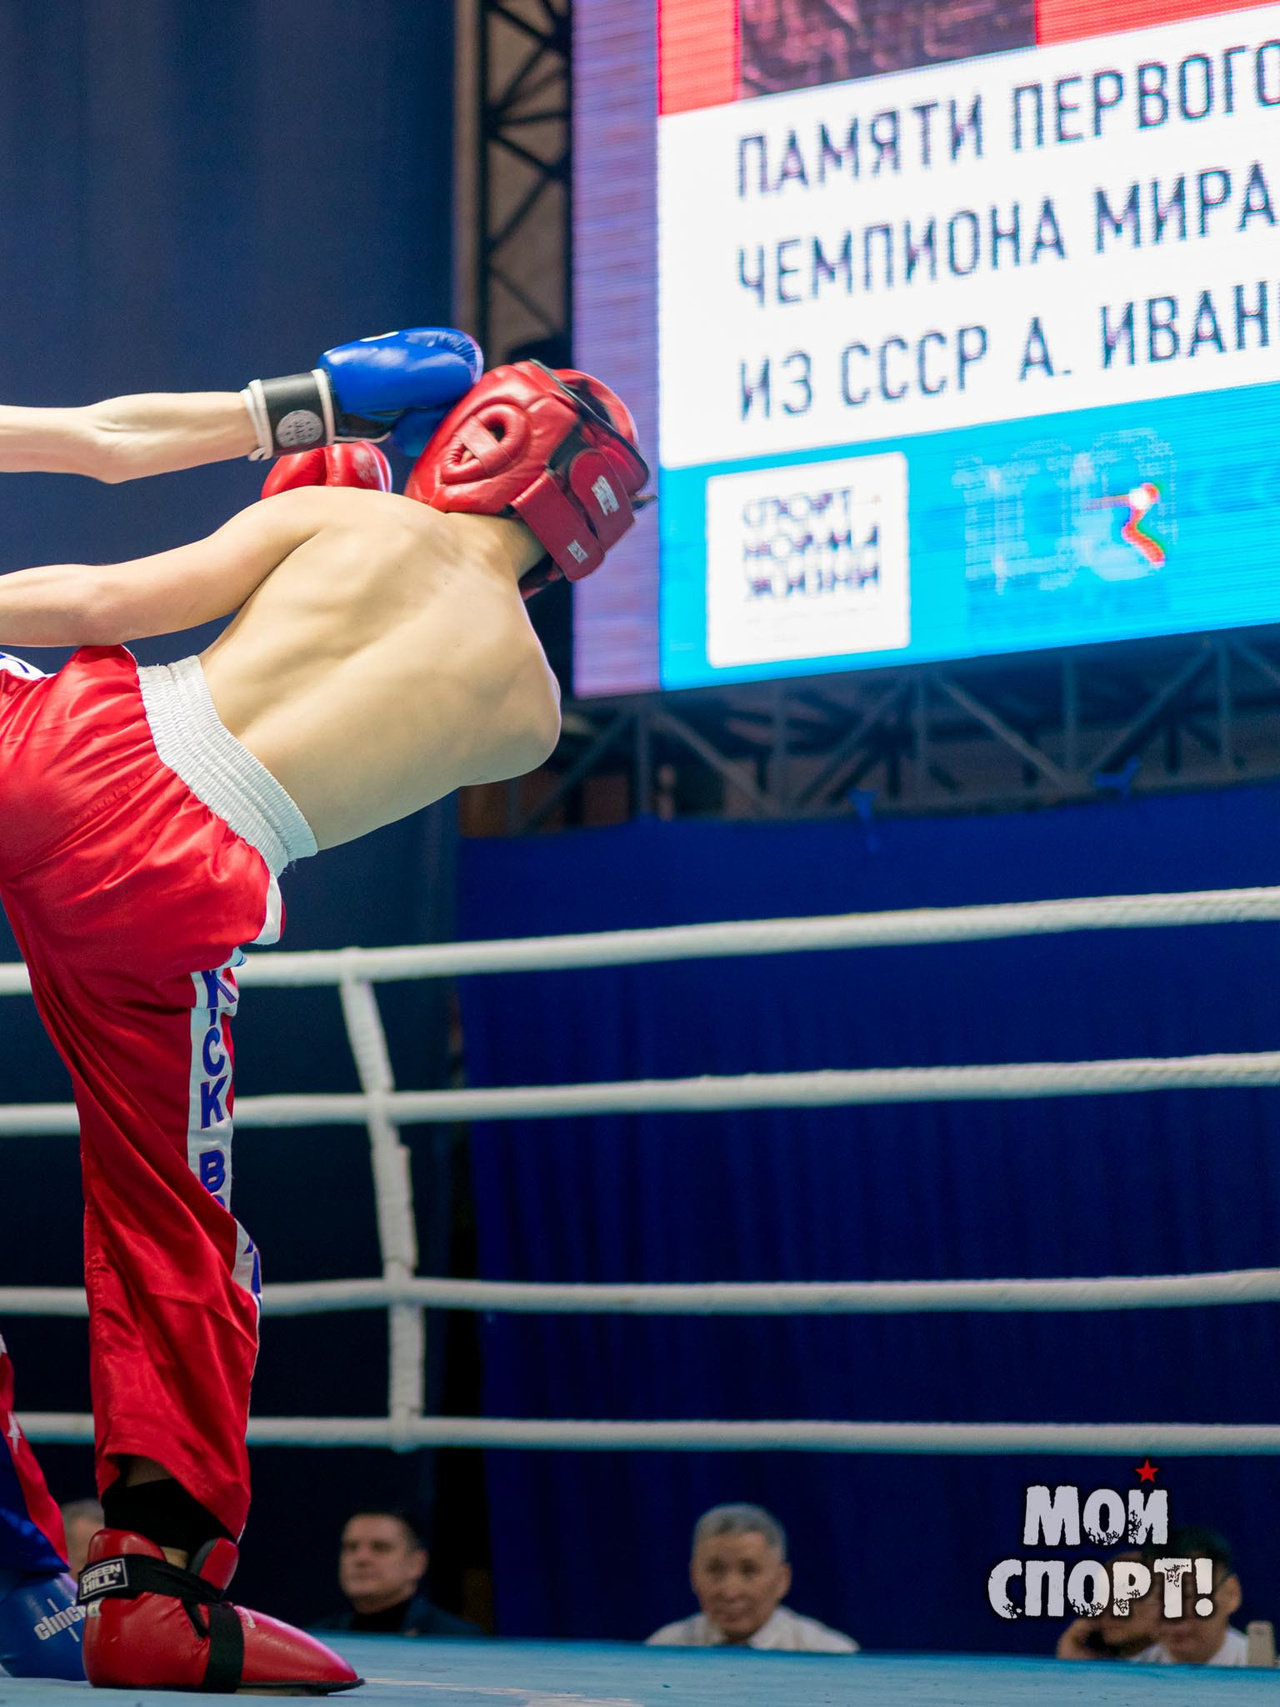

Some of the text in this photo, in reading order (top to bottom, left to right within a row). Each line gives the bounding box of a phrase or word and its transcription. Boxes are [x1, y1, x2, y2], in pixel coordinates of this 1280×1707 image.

[738, 39, 1280, 199] ПАМЯТИ ПЕРВОГО
[738, 160, 1278, 307] ЧЕМПИОНА МИРА
[740, 278, 1280, 421] ИЗ СССР А. ИВАН
[82, 1563, 121, 1584] GREEN
[83, 1575, 117, 1594] HILL
